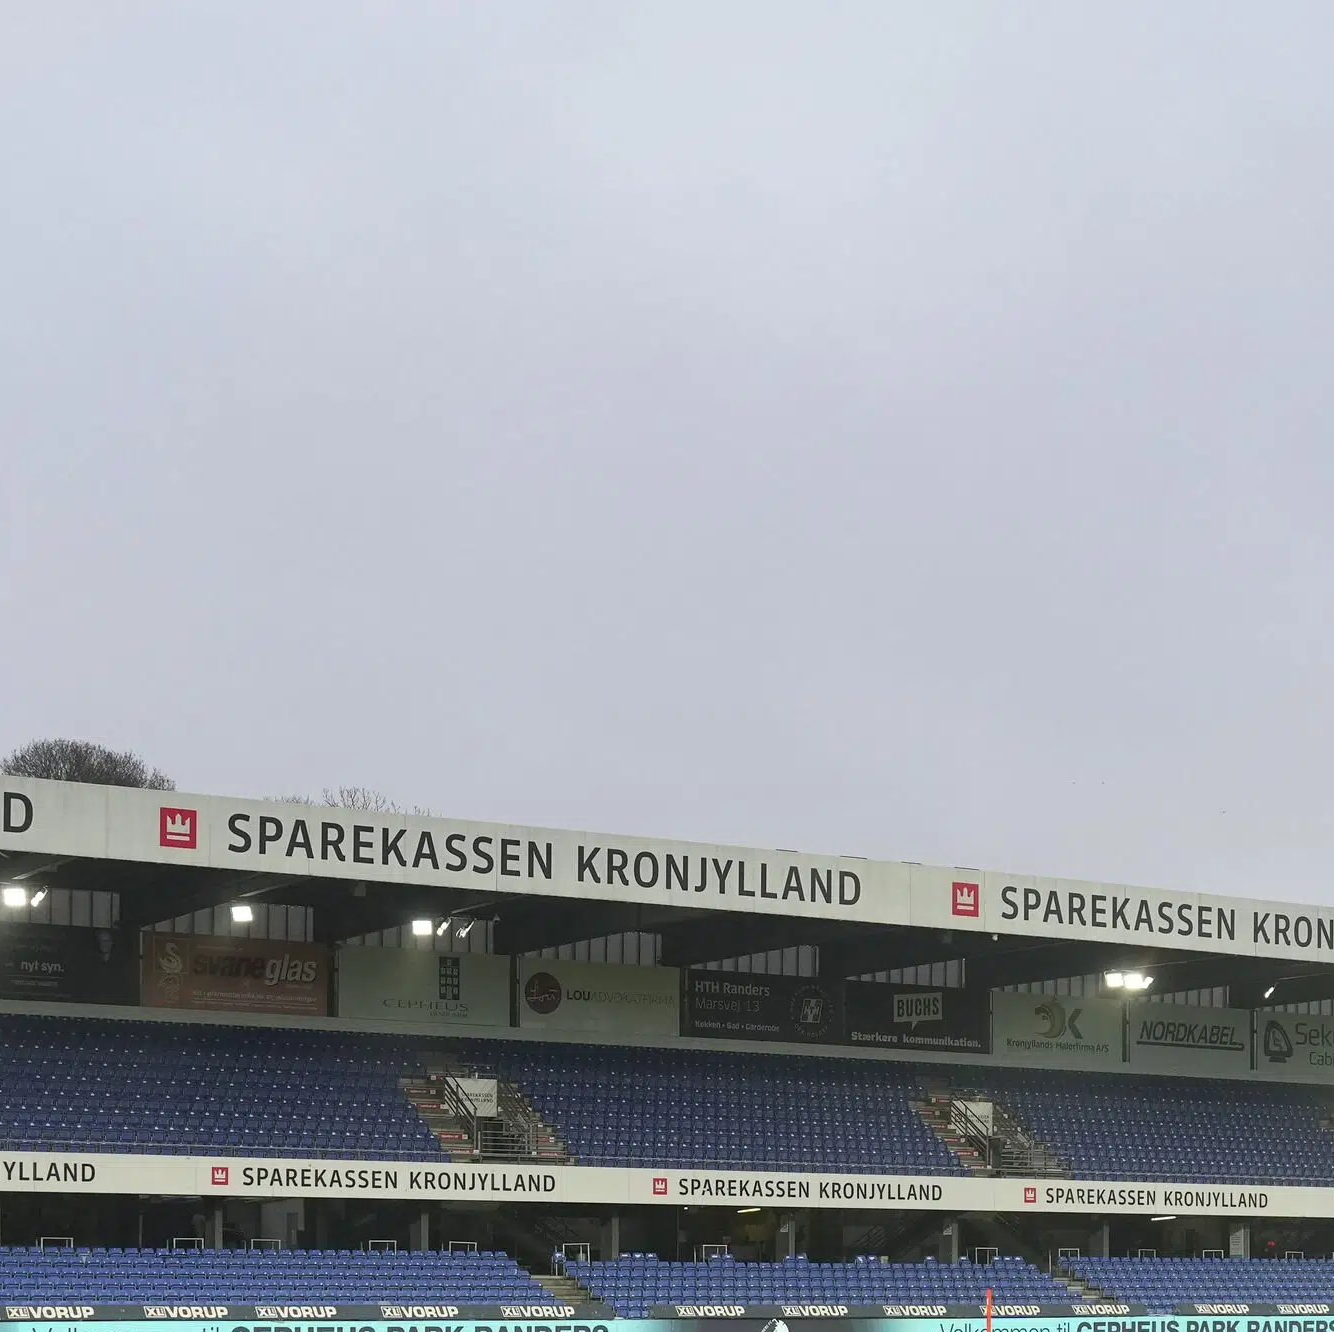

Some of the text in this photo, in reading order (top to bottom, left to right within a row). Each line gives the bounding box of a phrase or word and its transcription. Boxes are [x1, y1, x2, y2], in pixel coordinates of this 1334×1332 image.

[227, 813, 862, 906] SPAREKASSEN KRONJYLLAND
[1000, 885, 1236, 941] SPAREKASSEN
[193, 953, 318, 986] svaneglas
[695, 980, 770, 996] HTH Randers
[897, 999, 940, 1018] BUCHS
[1139, 1020, 1241, 1046] NORDKABEL
[851, 1031, 982, 1049] Stærkere kommunikation.
[1007, 1038, 1053, 1050] Kronjyllands
[242, 1165, 556, 1193] SPAREKASSEN KRONJYLLAND
[678, 1177, 943, 1202] SPAREKASSEN KRONJYLLAND
[1045, 1186, 1268, 1209] SPAREKASSEN KRONJYLLAND
[29, 1306, 94, 1318] VORUP
[166, 1306, 228, 1318] VORUP
[277, 1306, 337, 1318] VORUP
[401, 1306, 458, 1318] VORUP
[520, 1306, 575, 1318] VORUP
[694, 1305, 745, 1317] VORUP
[800, 1305, 848, 1317] VORUP
[900, 1305, 947, 1316] VORUP
[995, 1305, 1041, 1316] VORUP
[1087, 1304, 1130, 1315] VORUP
[1209, 1303, 1249, 1314] VORUP
[1291, 1303, 1330, 1314] VORUP
